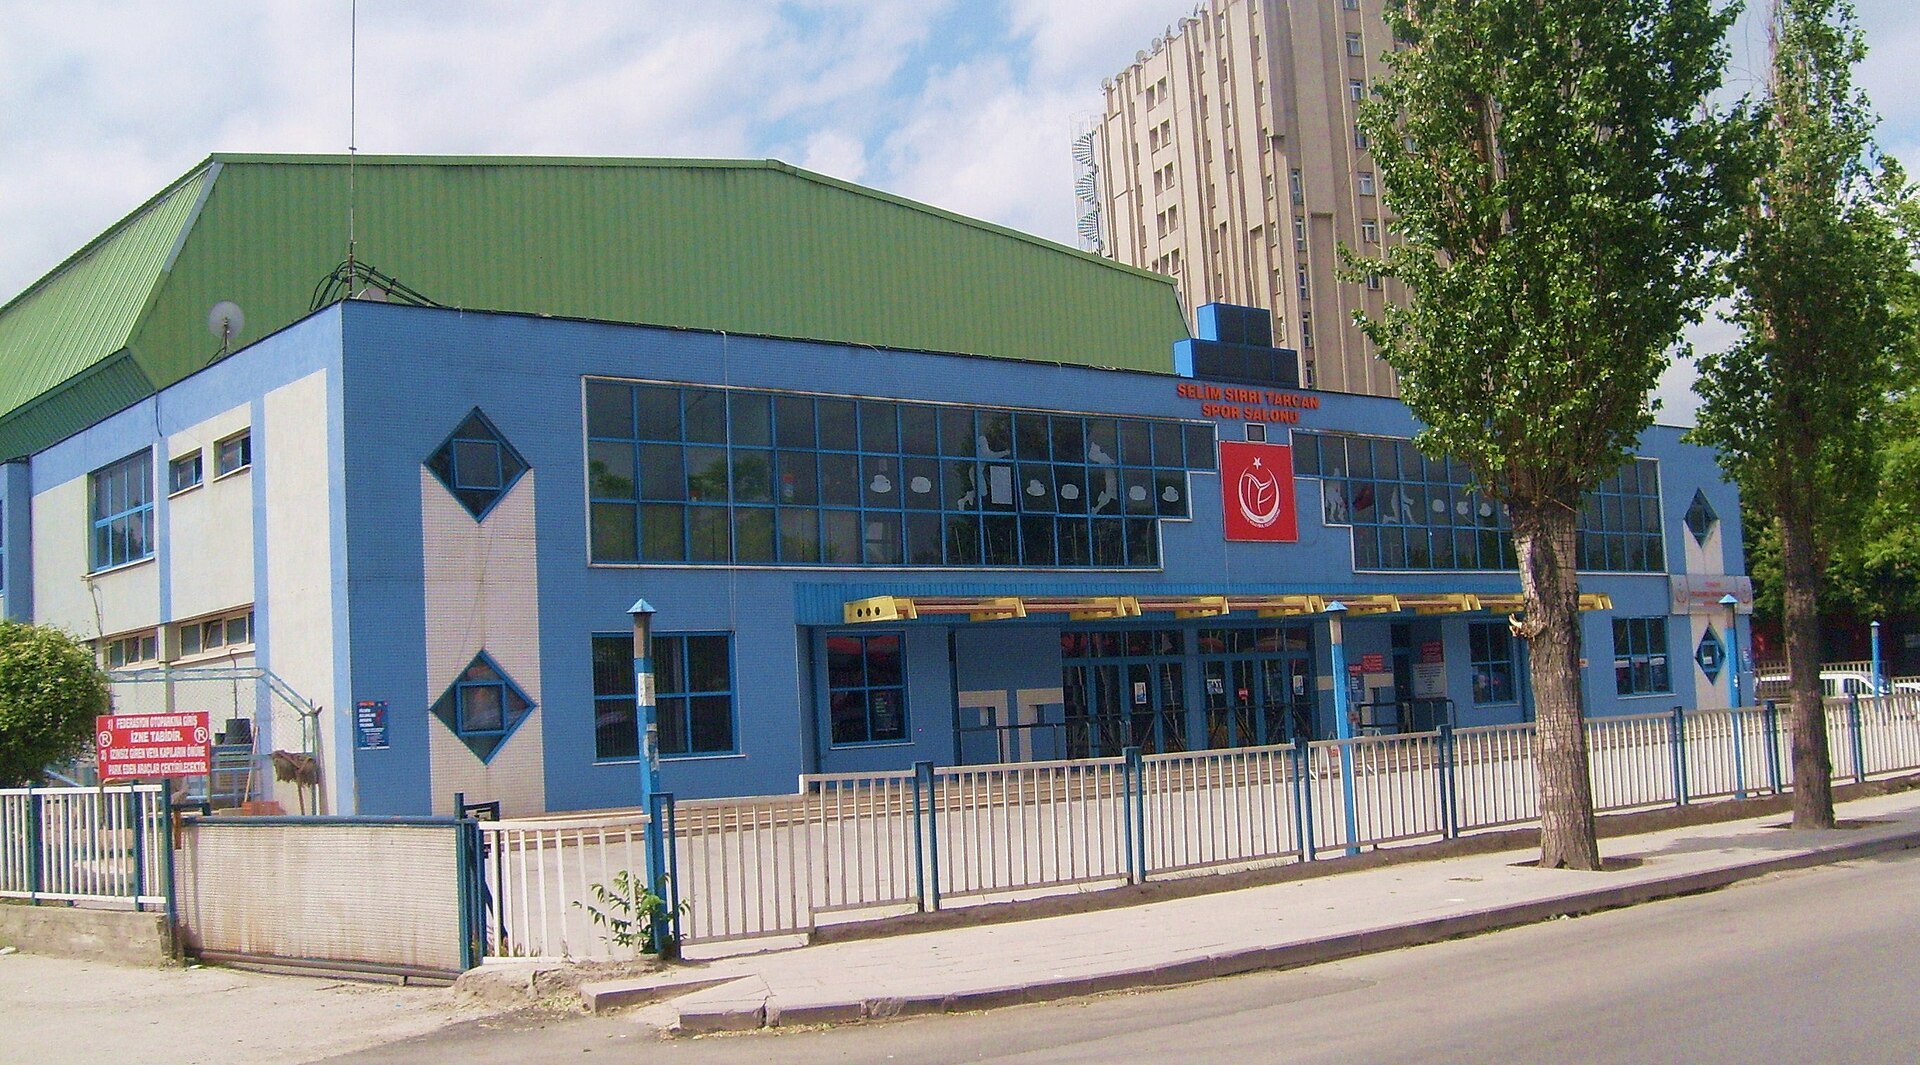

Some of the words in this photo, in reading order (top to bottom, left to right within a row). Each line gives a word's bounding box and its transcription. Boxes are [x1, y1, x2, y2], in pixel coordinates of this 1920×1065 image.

[1177, 383, 1221, 400] SELİM
[1225, 387, 1262, 404] SIRRI
[1266, 391, 1320, 410] TARCAN
[1202, 403, 1240, 419] SPOR
[1244, 407, 1299, 424] SALONU
[116, 717, 149, 729] FEDERASYON
[130, 730, 149, 743] İZNE
[108, 764, 122, 775] PARK
[122, 763, 137, 774] EDEN
